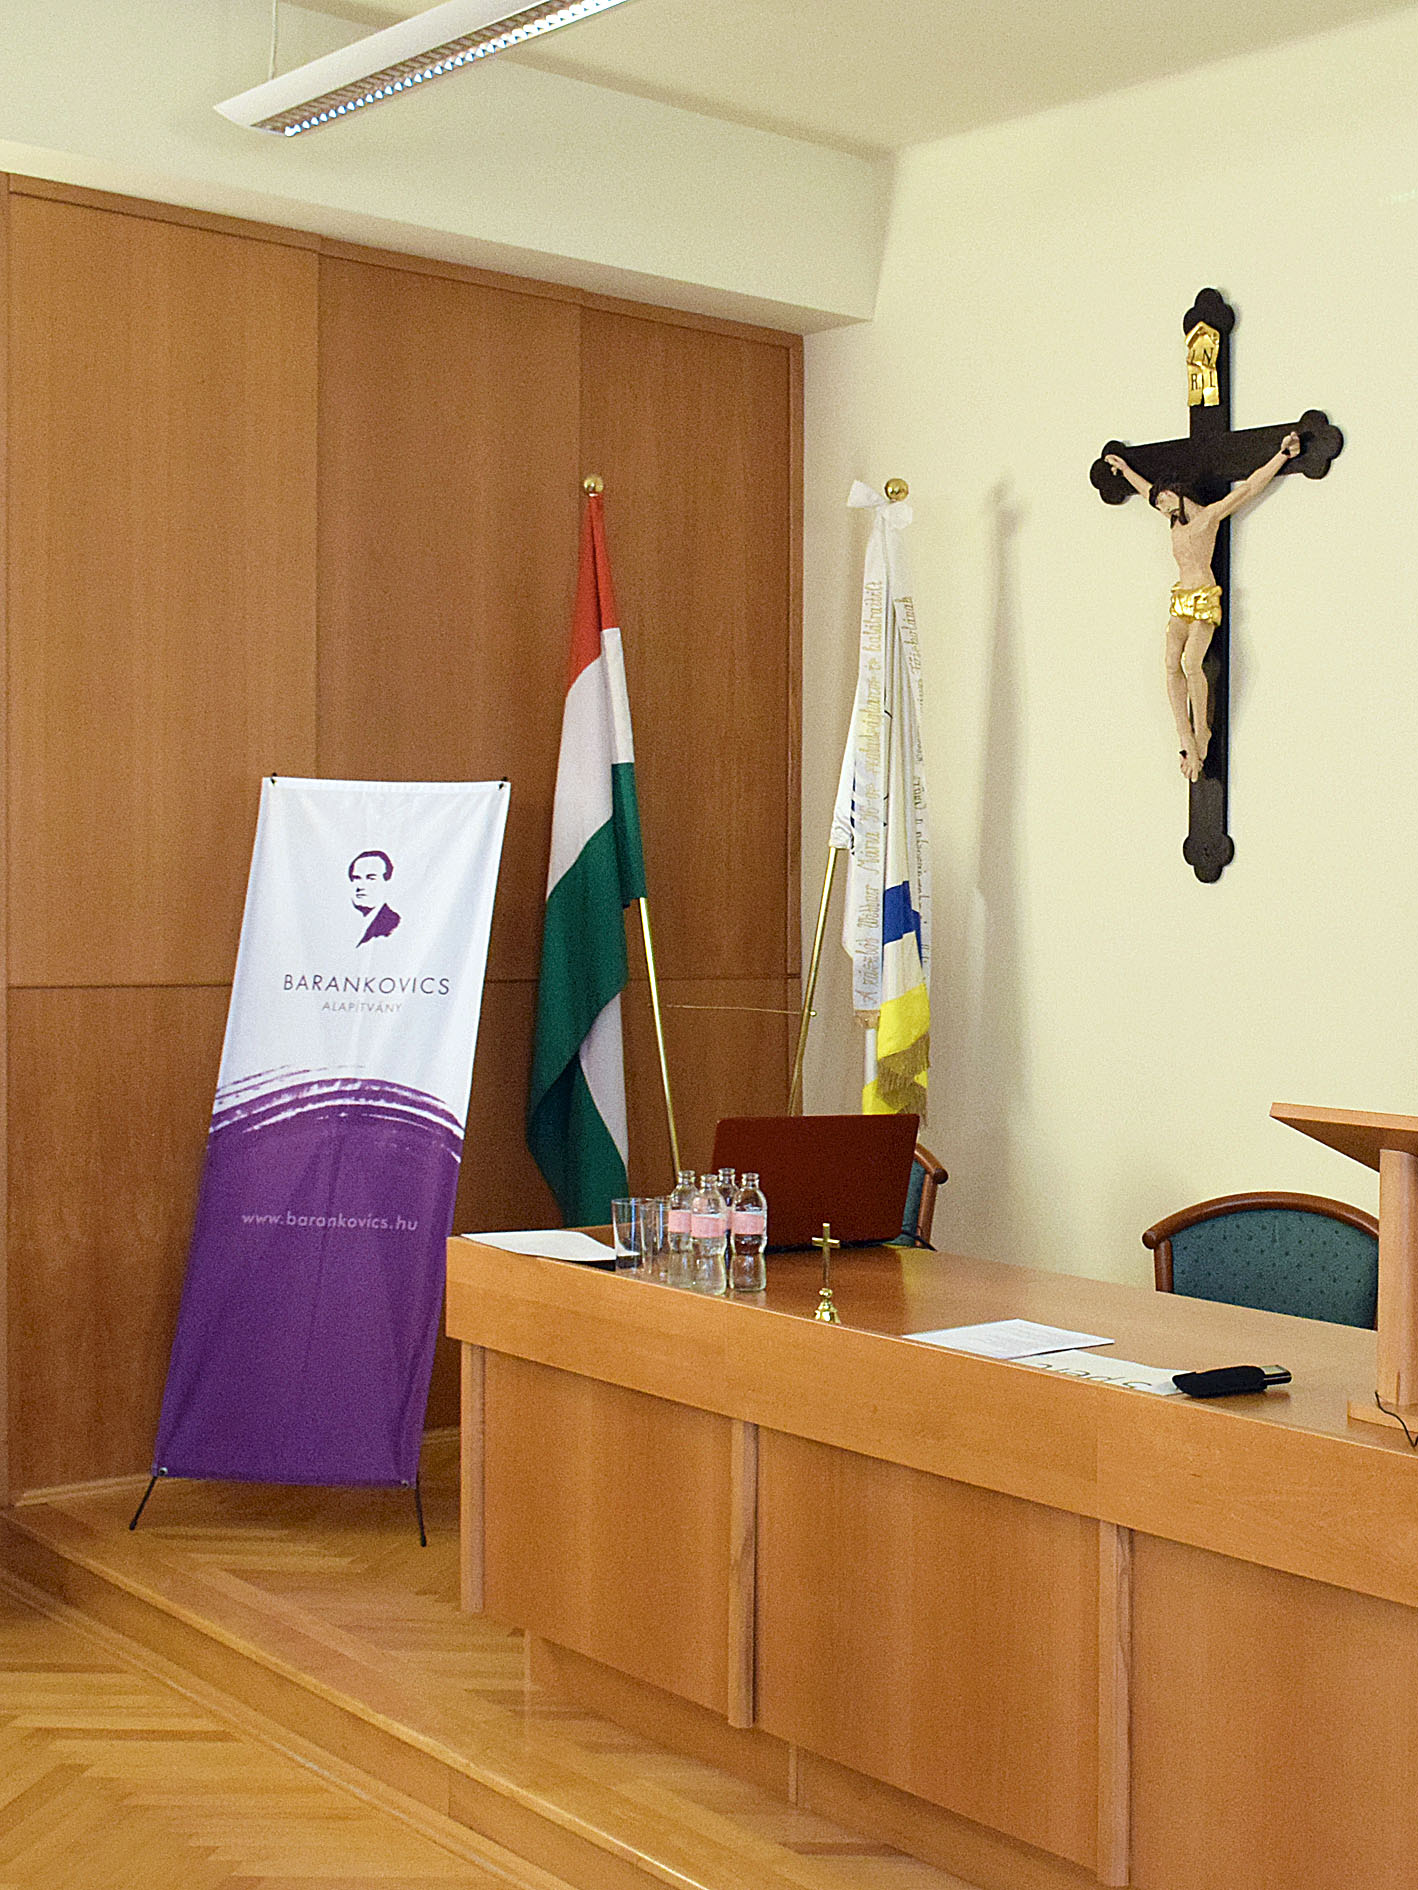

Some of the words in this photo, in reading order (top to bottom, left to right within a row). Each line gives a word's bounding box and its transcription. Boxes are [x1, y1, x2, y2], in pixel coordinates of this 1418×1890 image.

[283, 974, 451, 996] BARANKOVICS
[321, 1001, 403, 1014] ALAPÍTVÁNY
[242, 1211, 419, 1231] www.barankovics.hu
